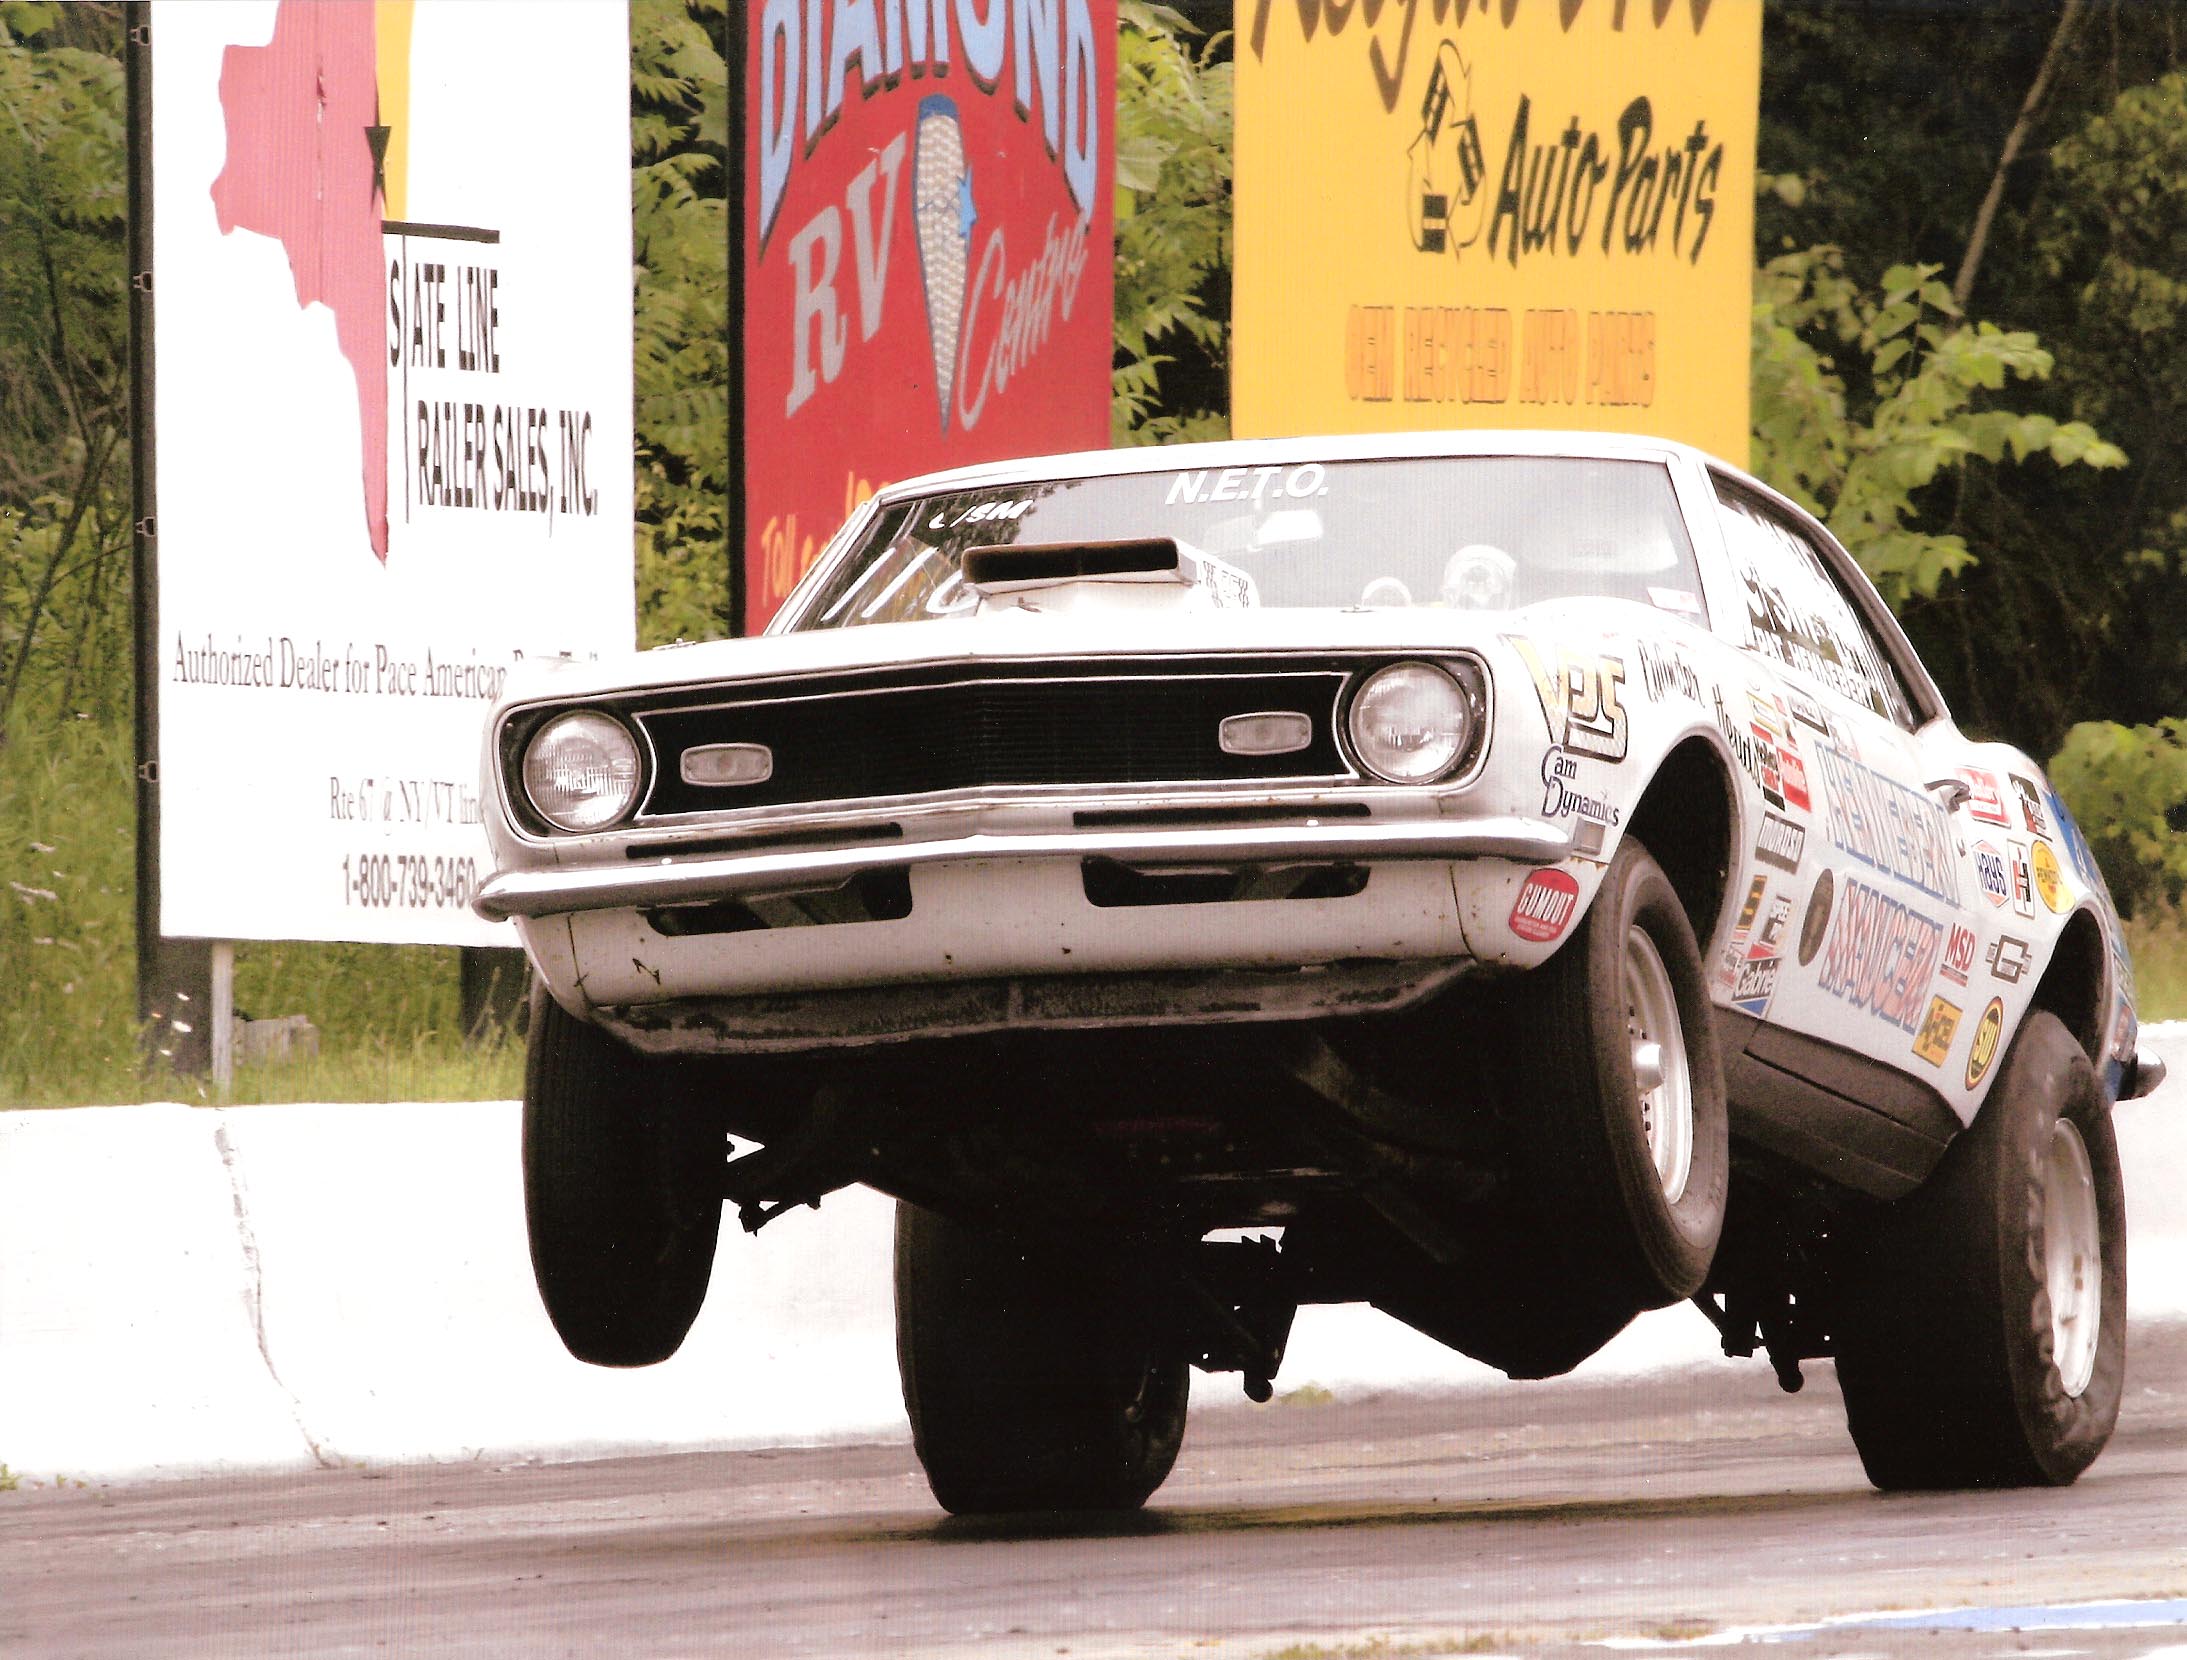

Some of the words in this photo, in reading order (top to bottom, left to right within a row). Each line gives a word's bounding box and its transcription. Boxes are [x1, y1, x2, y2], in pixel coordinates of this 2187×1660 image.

[1486, 93, 1608, 269] Auto
[1600, 95, 1723, 266] Parts
[785, 133, 906, 418] RV
[457, 265, 500, 374] LINE
[493, 404, 553, 538] SALES,
[560, 410, 598, 516] INC.
[1164, 463, 1328, 505] N.E.T.O.
[172, 630, 273, 687] Authorized
[279, 637, 340, 693] Dealer
[345, 642, 370, 694] for
[375, 644, 416, 697] Pace
[422, 646, 507, 701] American
[1541, 744, 1577, 787] Cam
[330, 776, 355, 820] Rte
[1542, 776, 1619, 827] Dynamics
[342, 853, 477, 908] 1-800-739-3460
[1517, 882, 1574, 925] GUMOUT
[1945, 922, 1976, 972] MSD
